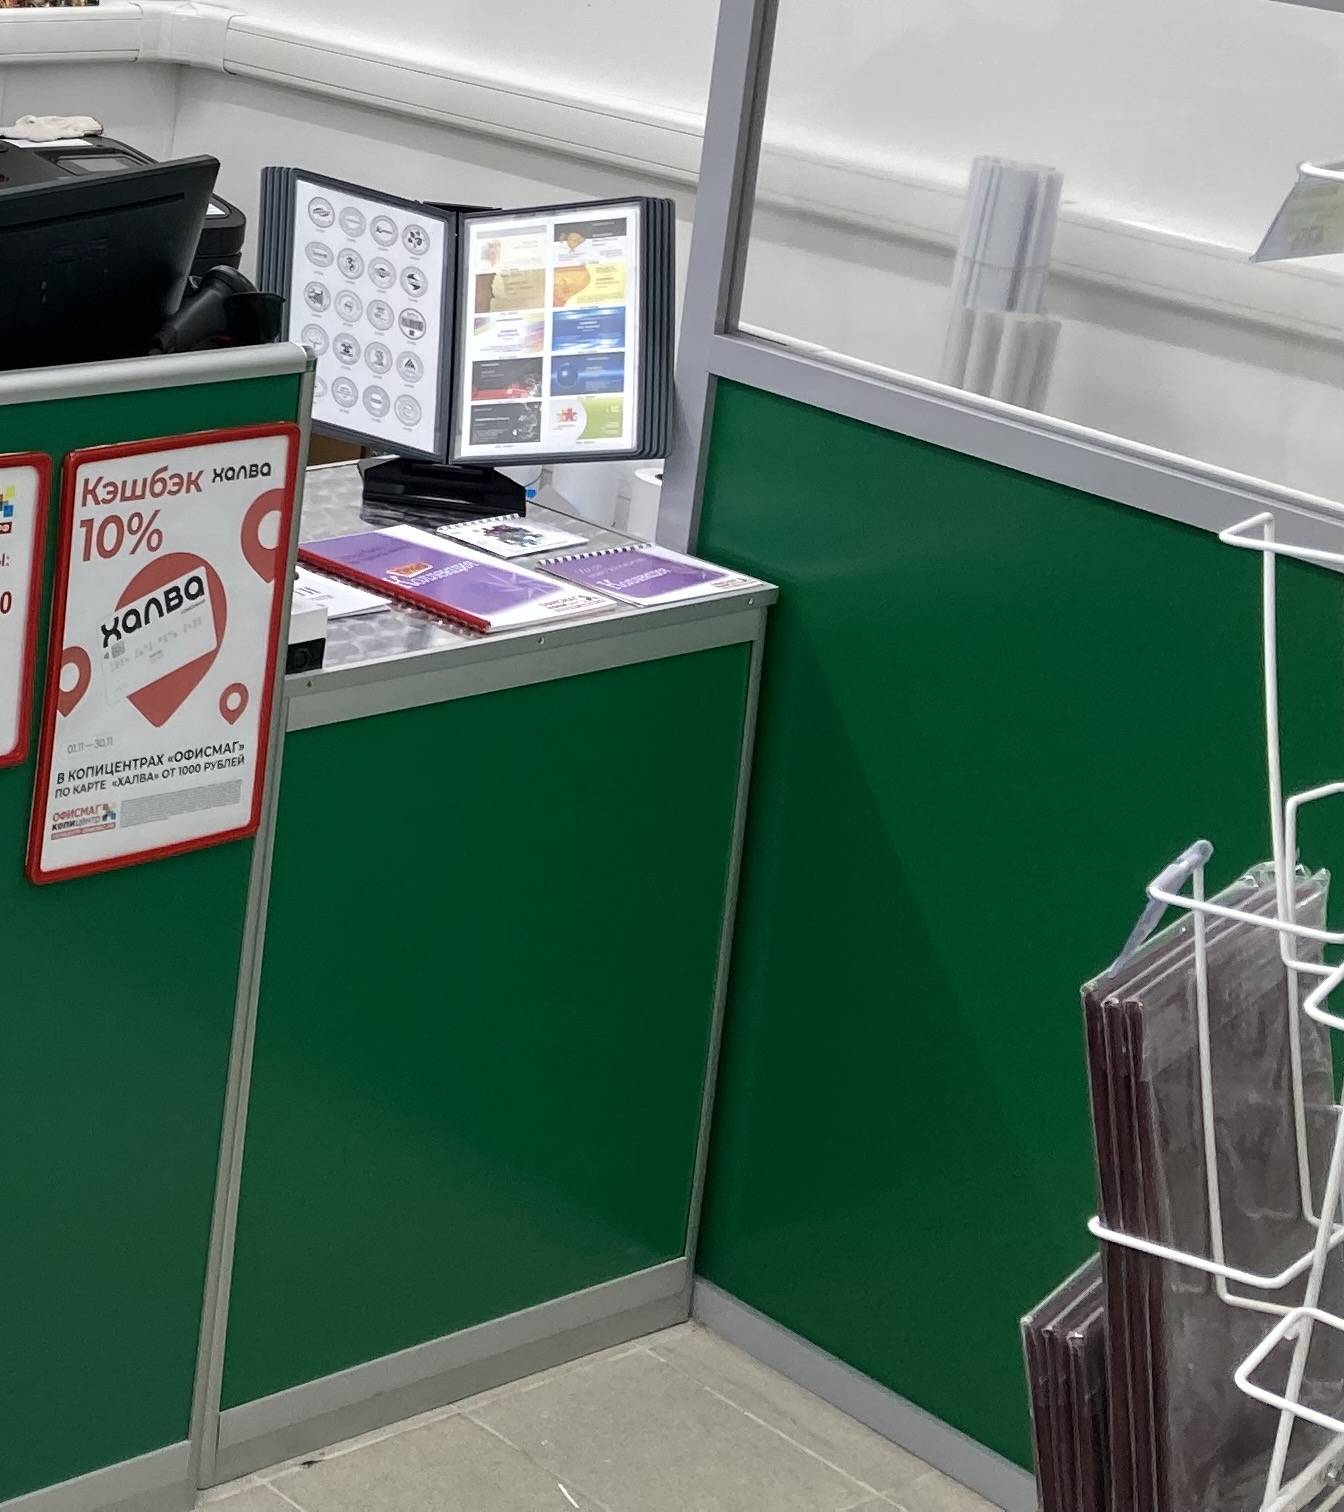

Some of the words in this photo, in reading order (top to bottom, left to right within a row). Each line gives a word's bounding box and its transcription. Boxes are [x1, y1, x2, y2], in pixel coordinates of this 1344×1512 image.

[81, 465, 205, 508] Кэшбэк
[79, 509, 164, 563] 10%
[67, 753, 165, 782] КОПИЦЕНТРАХ
[167, 740, 246, 764] «ОФИСМАГ»
[73, 779, 107, 796] КАРТЕ
[161, 767, 176, 780] ОТ
[178, 764, 202, 778] 1000
[204, 753, 246, 772] РУБЛЕЙ
